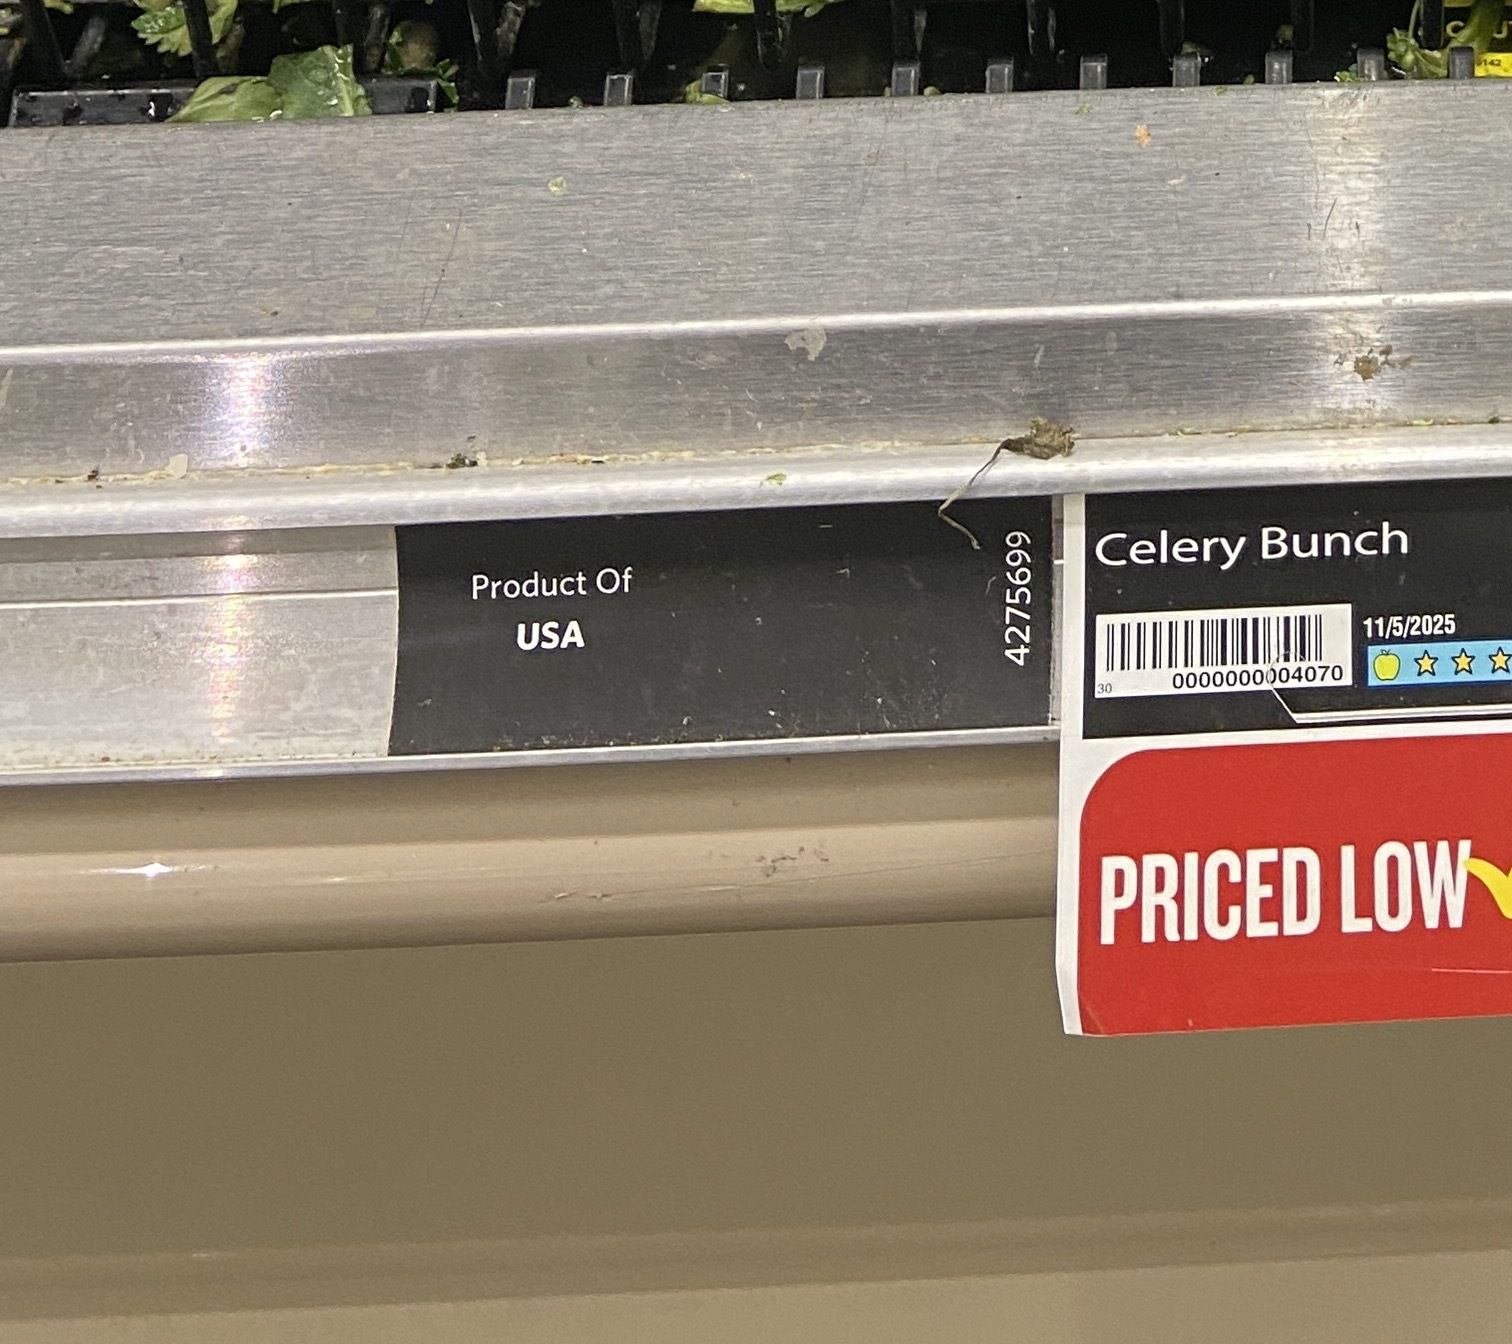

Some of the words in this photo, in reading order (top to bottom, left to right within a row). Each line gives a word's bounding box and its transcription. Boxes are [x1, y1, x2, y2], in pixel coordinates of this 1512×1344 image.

[1095, 528, 1247, 571] Celery
[1261, 521, 1409, 560] Bunch
[472, 569, 587, 600] Product
[596, 566, 633, 595] Of
[1004, 530, 1032, 666] 4275699
[516, 620, 585, 651] USA
[1363, 614, 1457, 639] 11/5/2025
[1097, 683, 1113, 694] 30
[1100, 844, 1318, 946] PRICED
[1341, 838, 1472, 934] LOW
